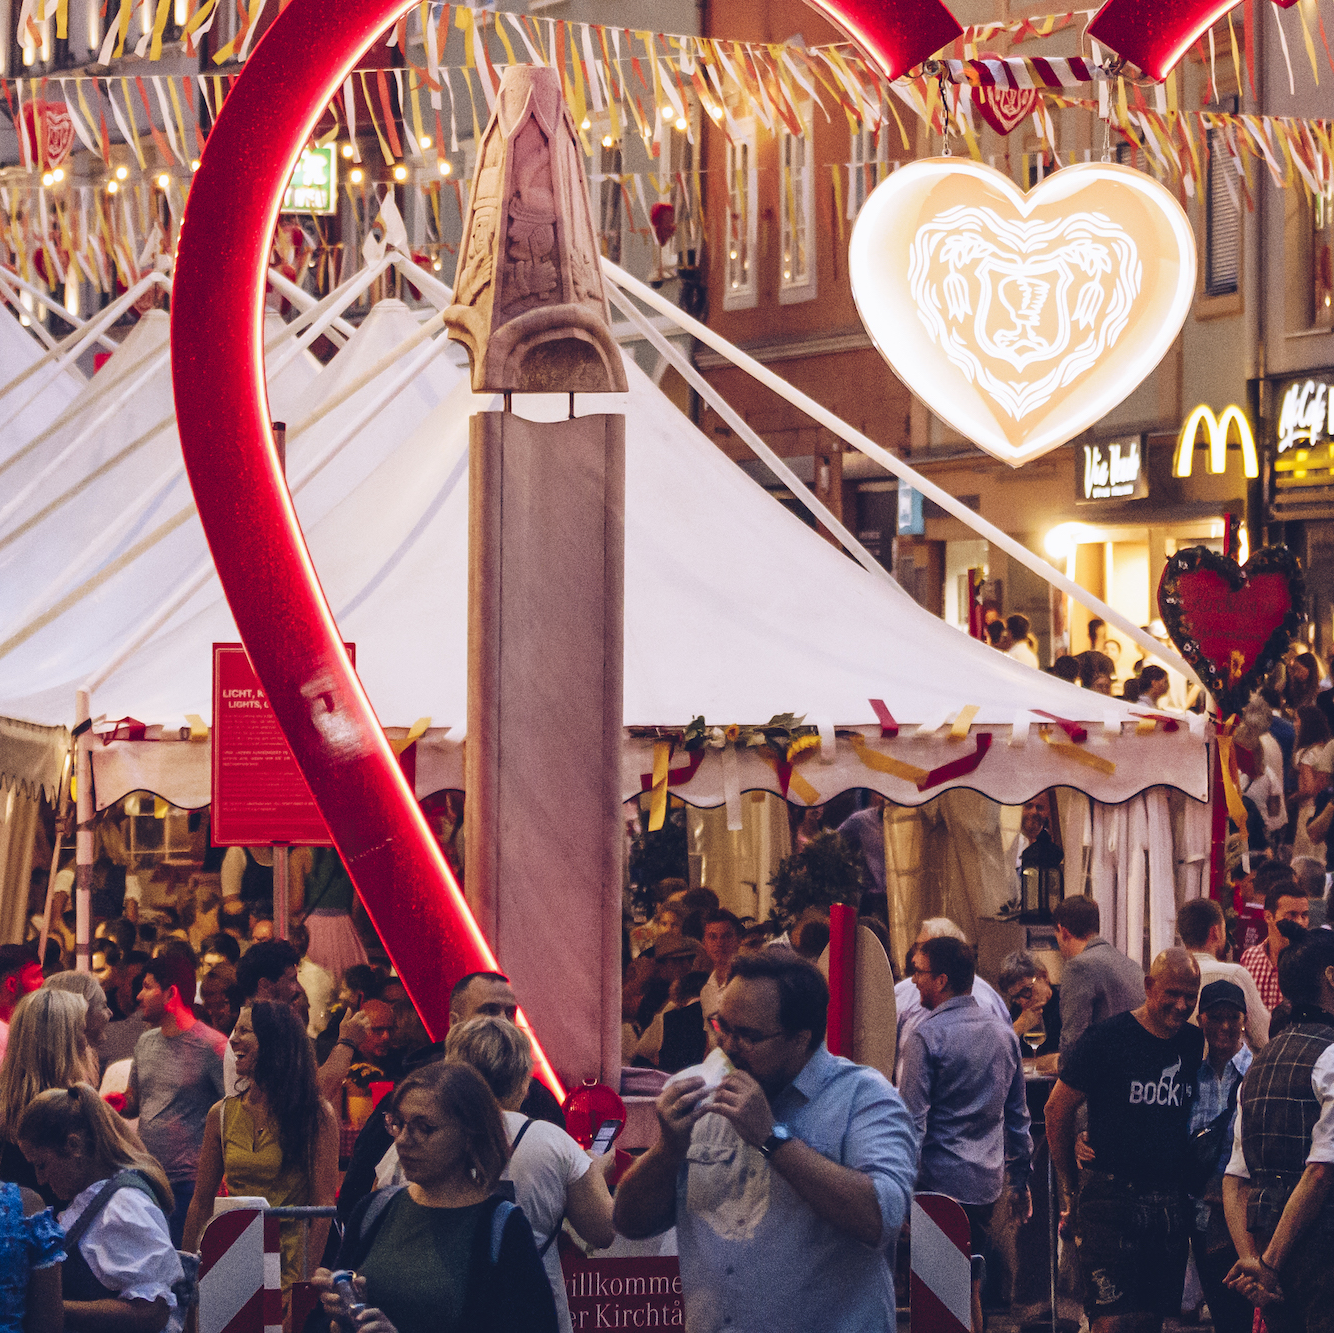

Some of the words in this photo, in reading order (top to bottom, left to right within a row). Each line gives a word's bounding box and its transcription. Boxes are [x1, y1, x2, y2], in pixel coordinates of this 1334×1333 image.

[222, 689, 256, 700] LICHT,
[228, 701, 263, 710] LIGHTS,
[565, 1272, 683, 1297] illkomme
